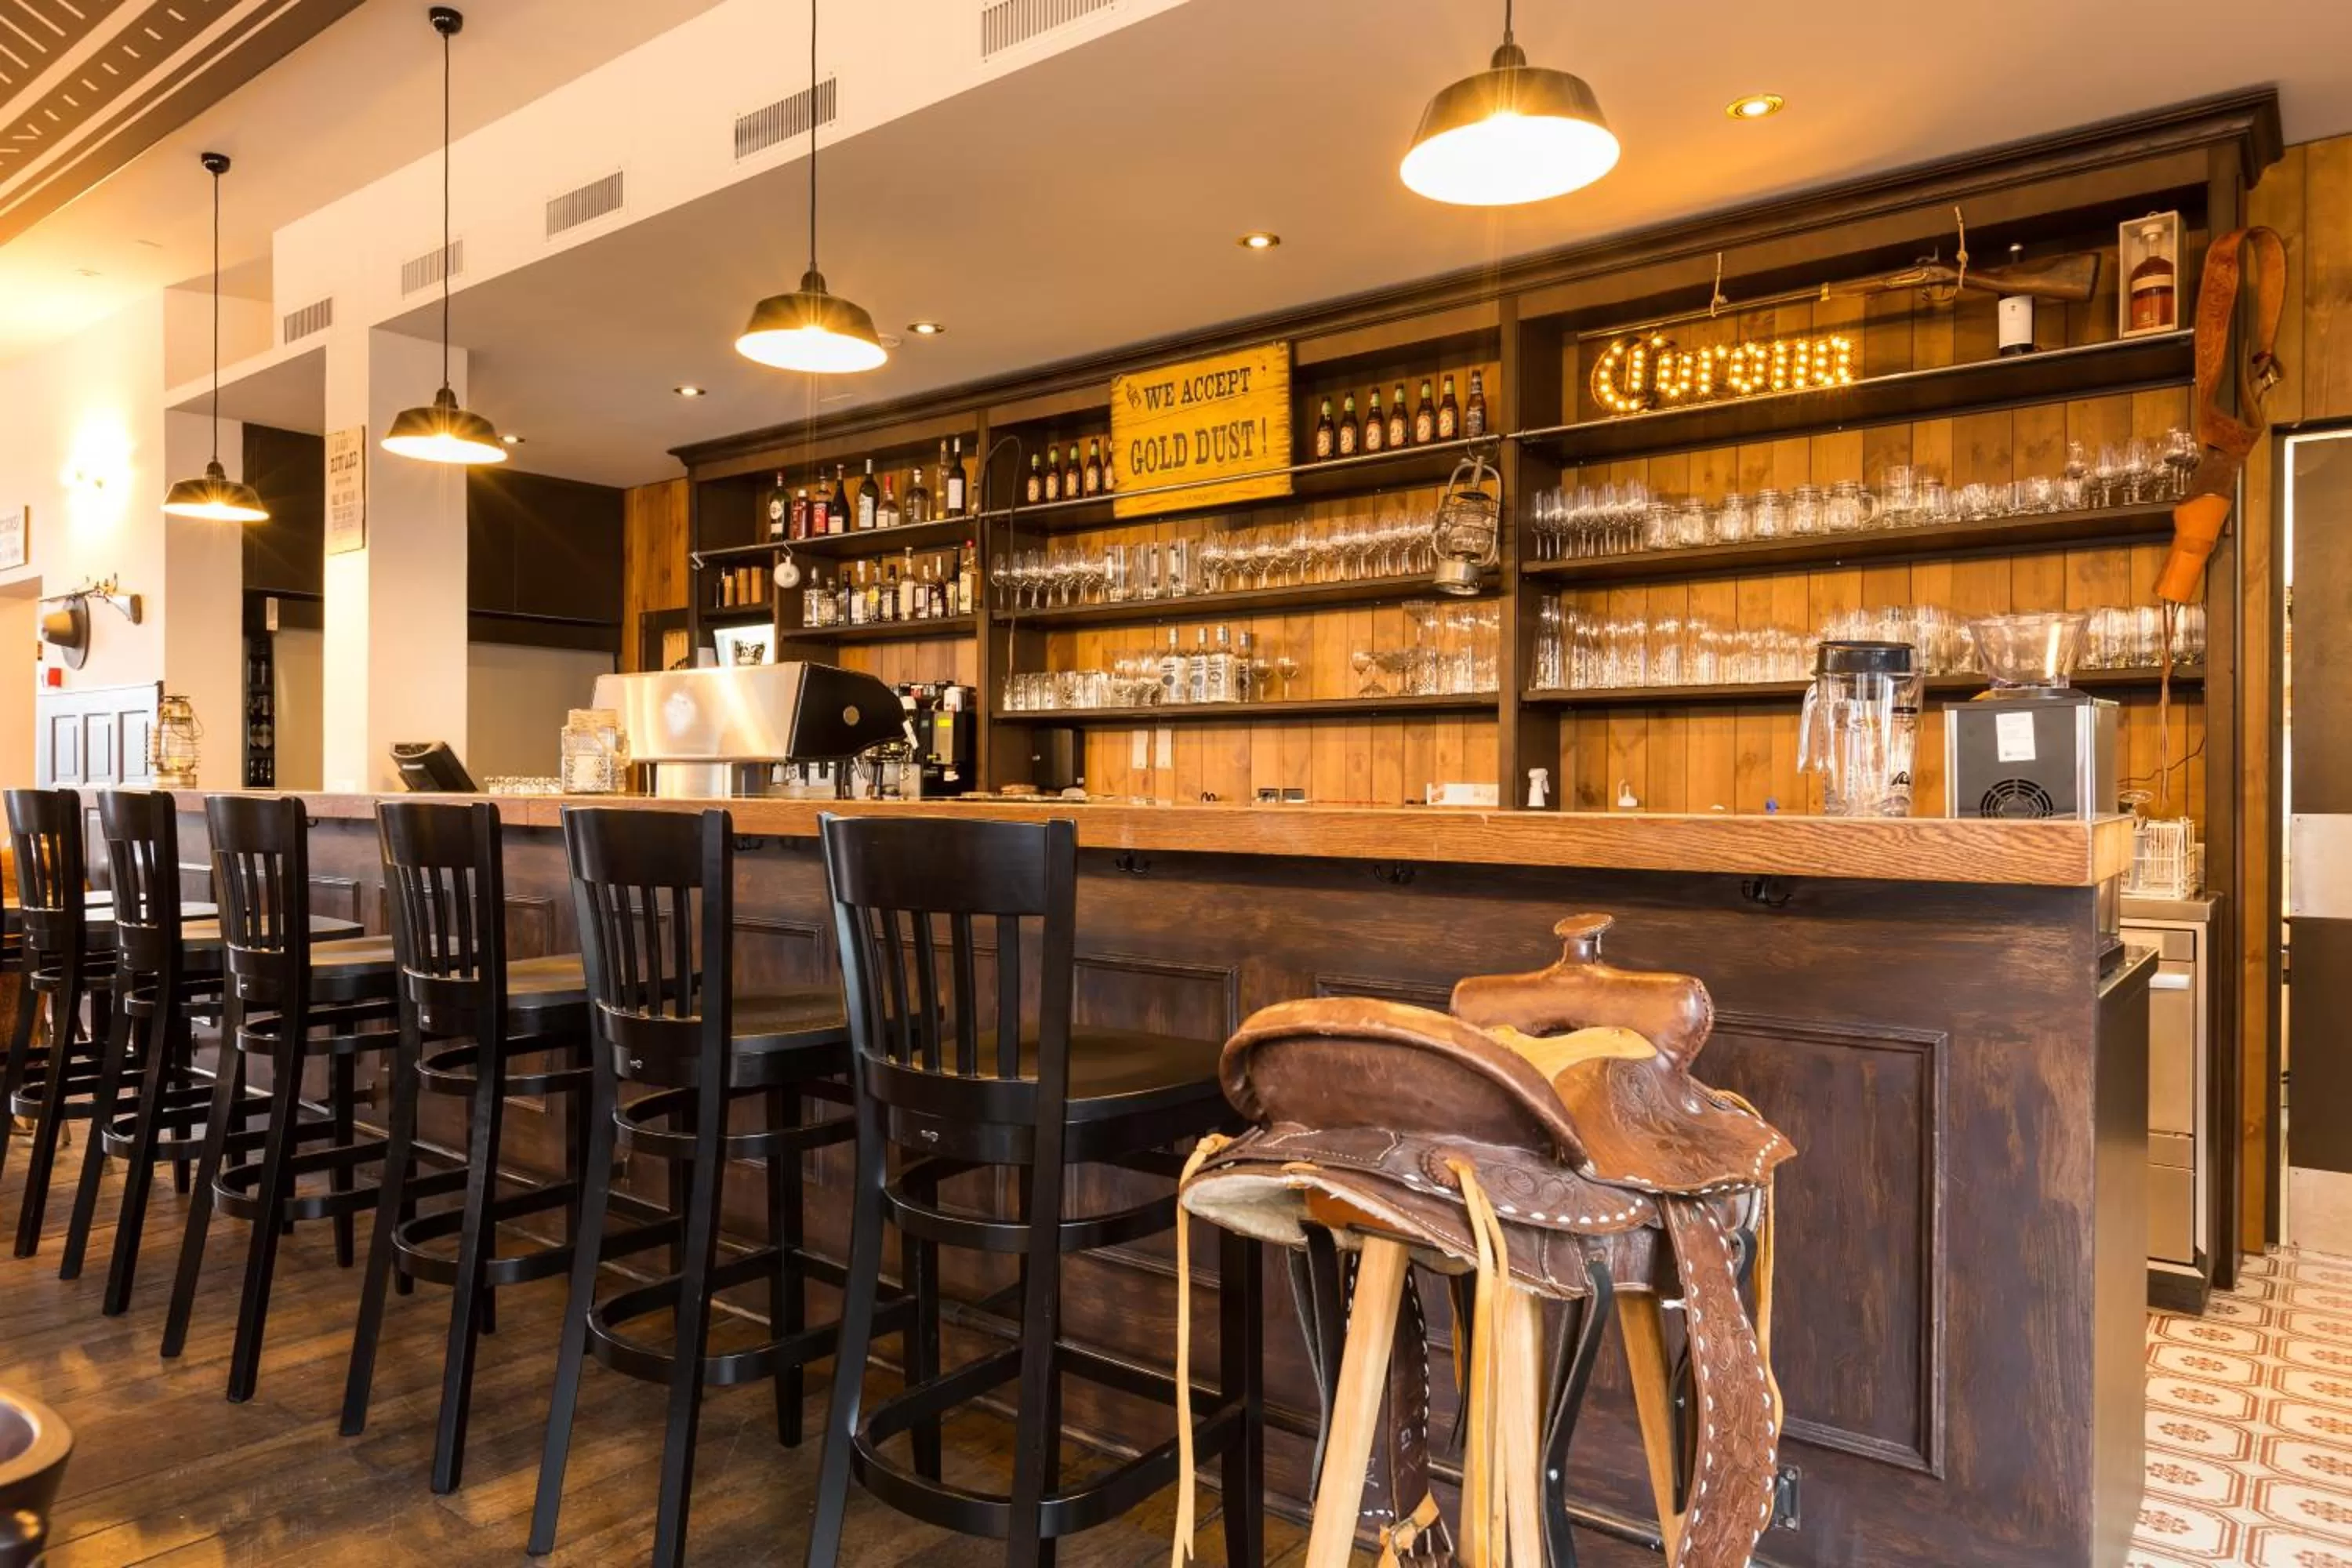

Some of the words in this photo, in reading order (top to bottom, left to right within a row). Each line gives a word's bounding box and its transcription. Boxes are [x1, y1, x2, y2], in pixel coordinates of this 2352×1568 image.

[1144, 382, 1174, 412] WE
[1181, 366, 1251, 405] ACCEPT
[1131, 432, 1188, 476] GOLD
